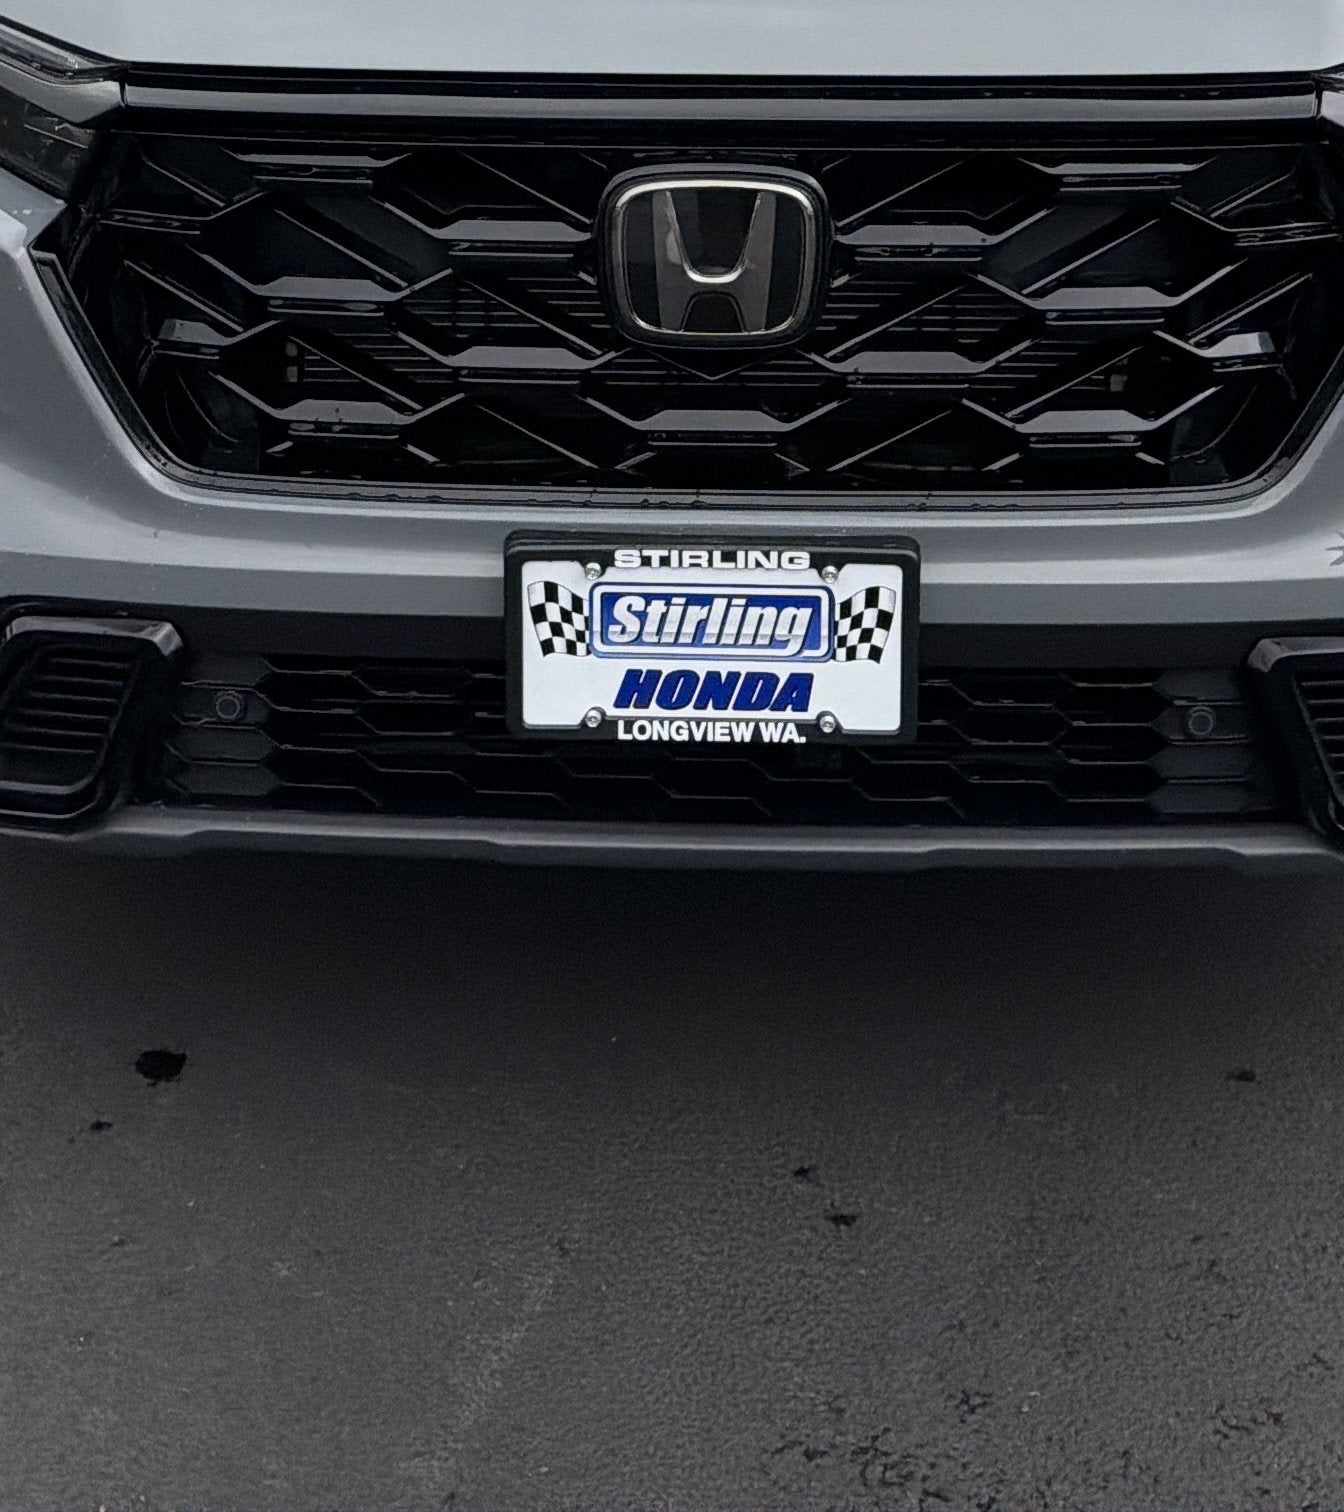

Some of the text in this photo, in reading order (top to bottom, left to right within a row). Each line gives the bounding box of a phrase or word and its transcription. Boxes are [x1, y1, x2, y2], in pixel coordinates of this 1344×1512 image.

[613, 548, 811, 570] STIRLING
[607, 594, 813, 656] Stirling
[613, 668, 815, 713] HONDA
[617, 719, 807, 743] LONGVIEW WA.
